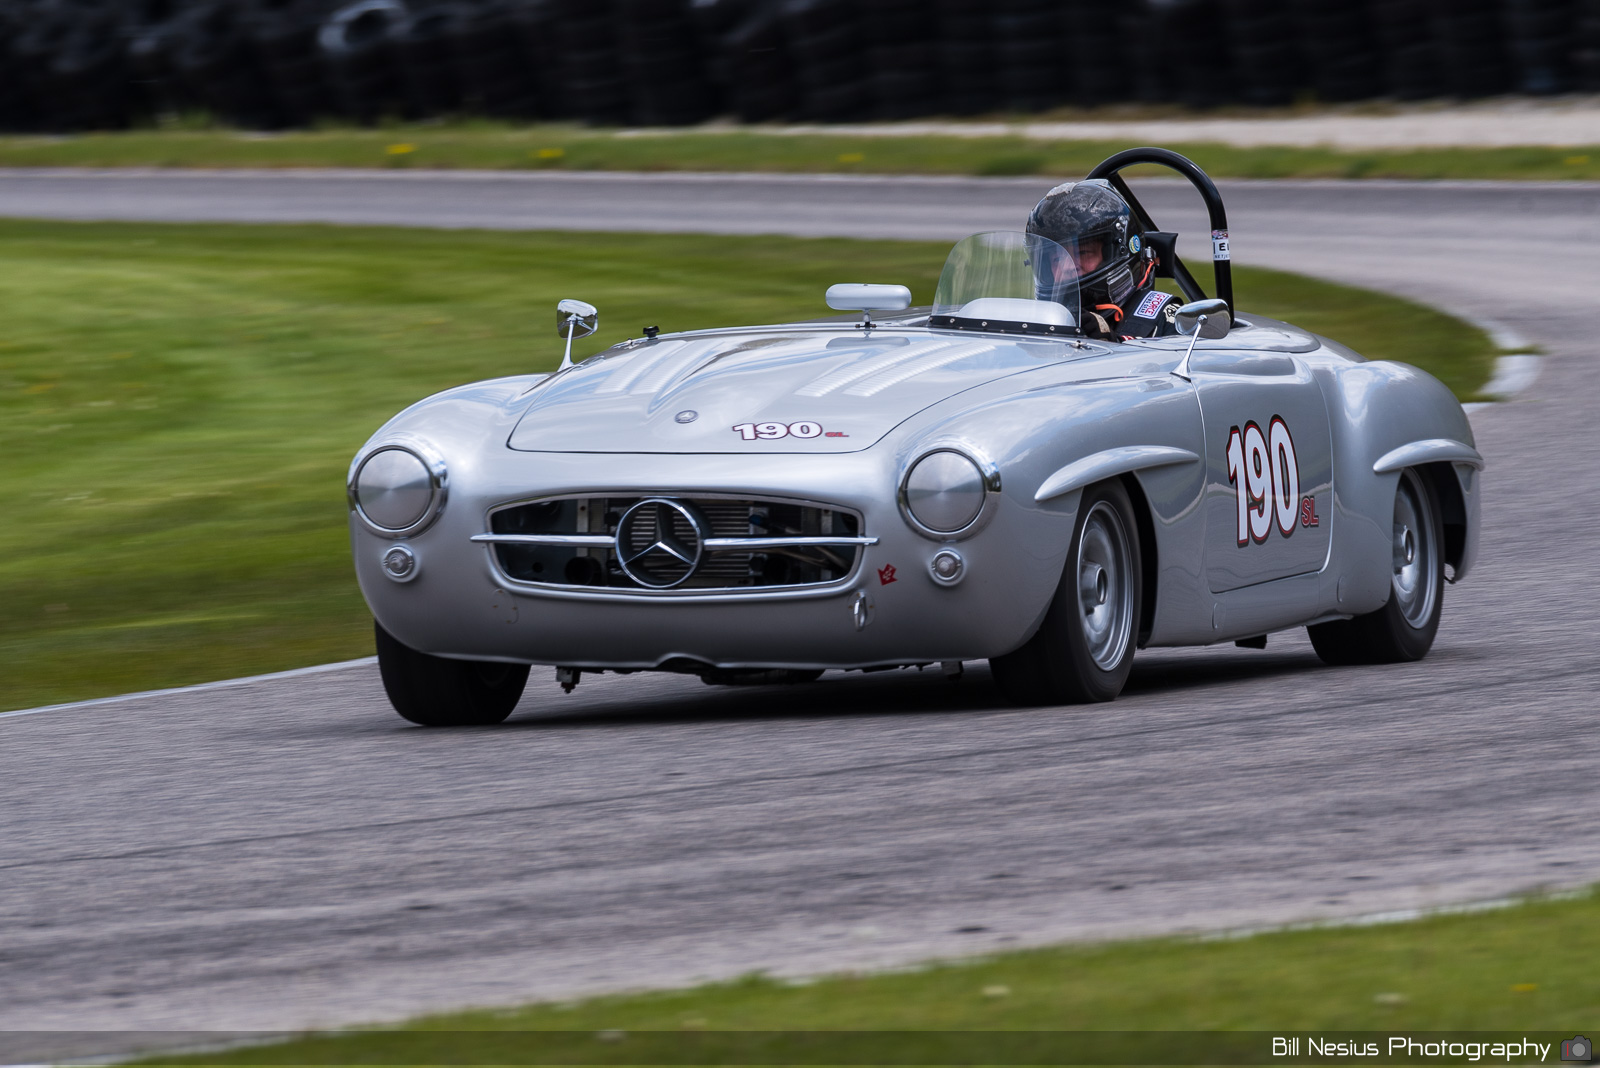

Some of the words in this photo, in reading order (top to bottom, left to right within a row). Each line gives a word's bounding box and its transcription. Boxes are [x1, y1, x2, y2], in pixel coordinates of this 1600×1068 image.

[733, 421, 822, 440] 190
[1226, 414, 1300, 548] 190
[1302, 496, 1319, 528] SL
